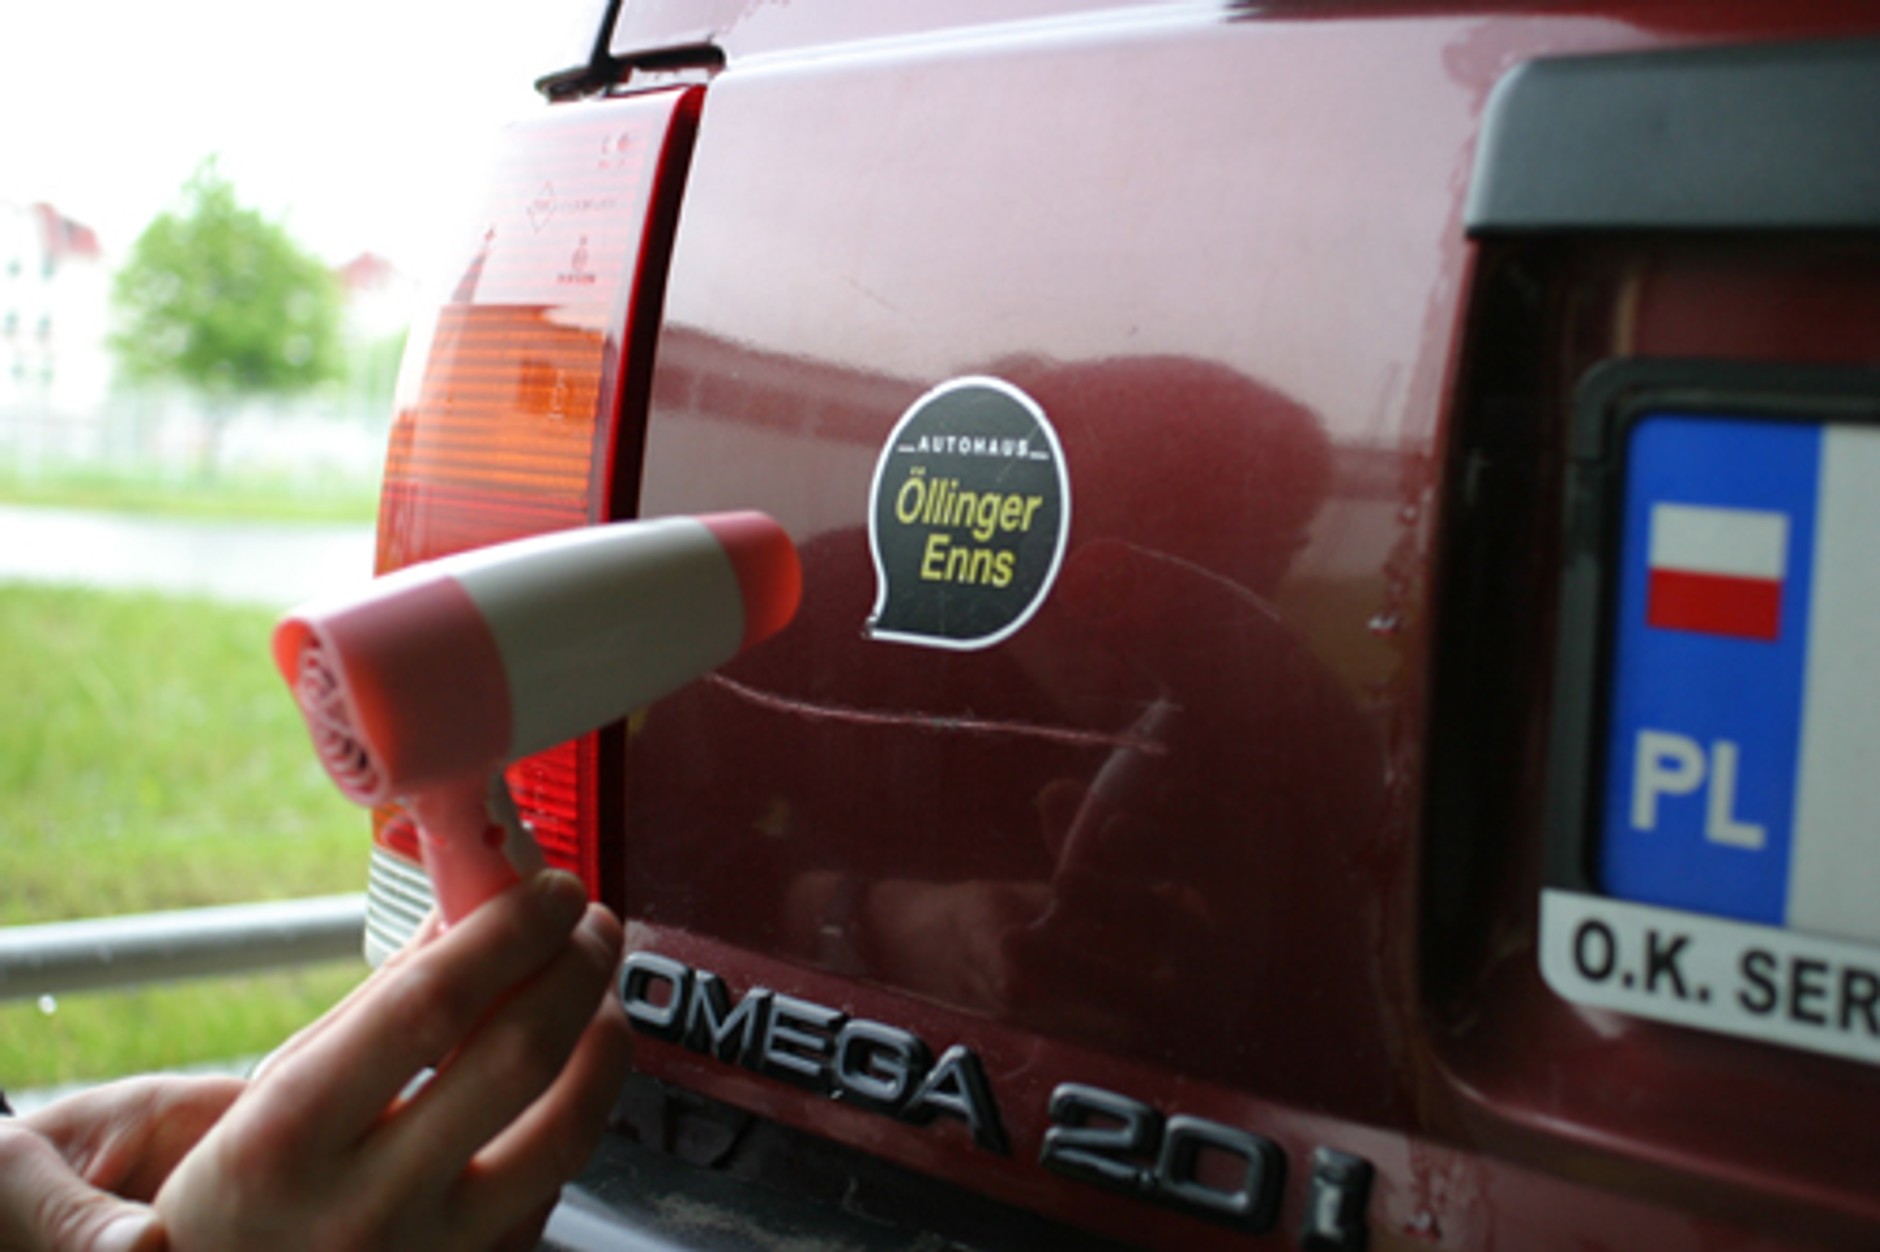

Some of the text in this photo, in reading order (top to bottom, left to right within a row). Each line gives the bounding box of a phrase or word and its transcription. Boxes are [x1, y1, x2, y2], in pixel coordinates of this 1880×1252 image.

[918, 436, 1028, 457] AUTOHAUS
[896, 467, 1043, 542] Öllinger
[920, 534, 1016, 588] Enns
[1630, 728, 1767, 850] PL
[1572, 918, 1880, 1037] O.K. SER
[618, 951, 1009, 1154] OMEGA
